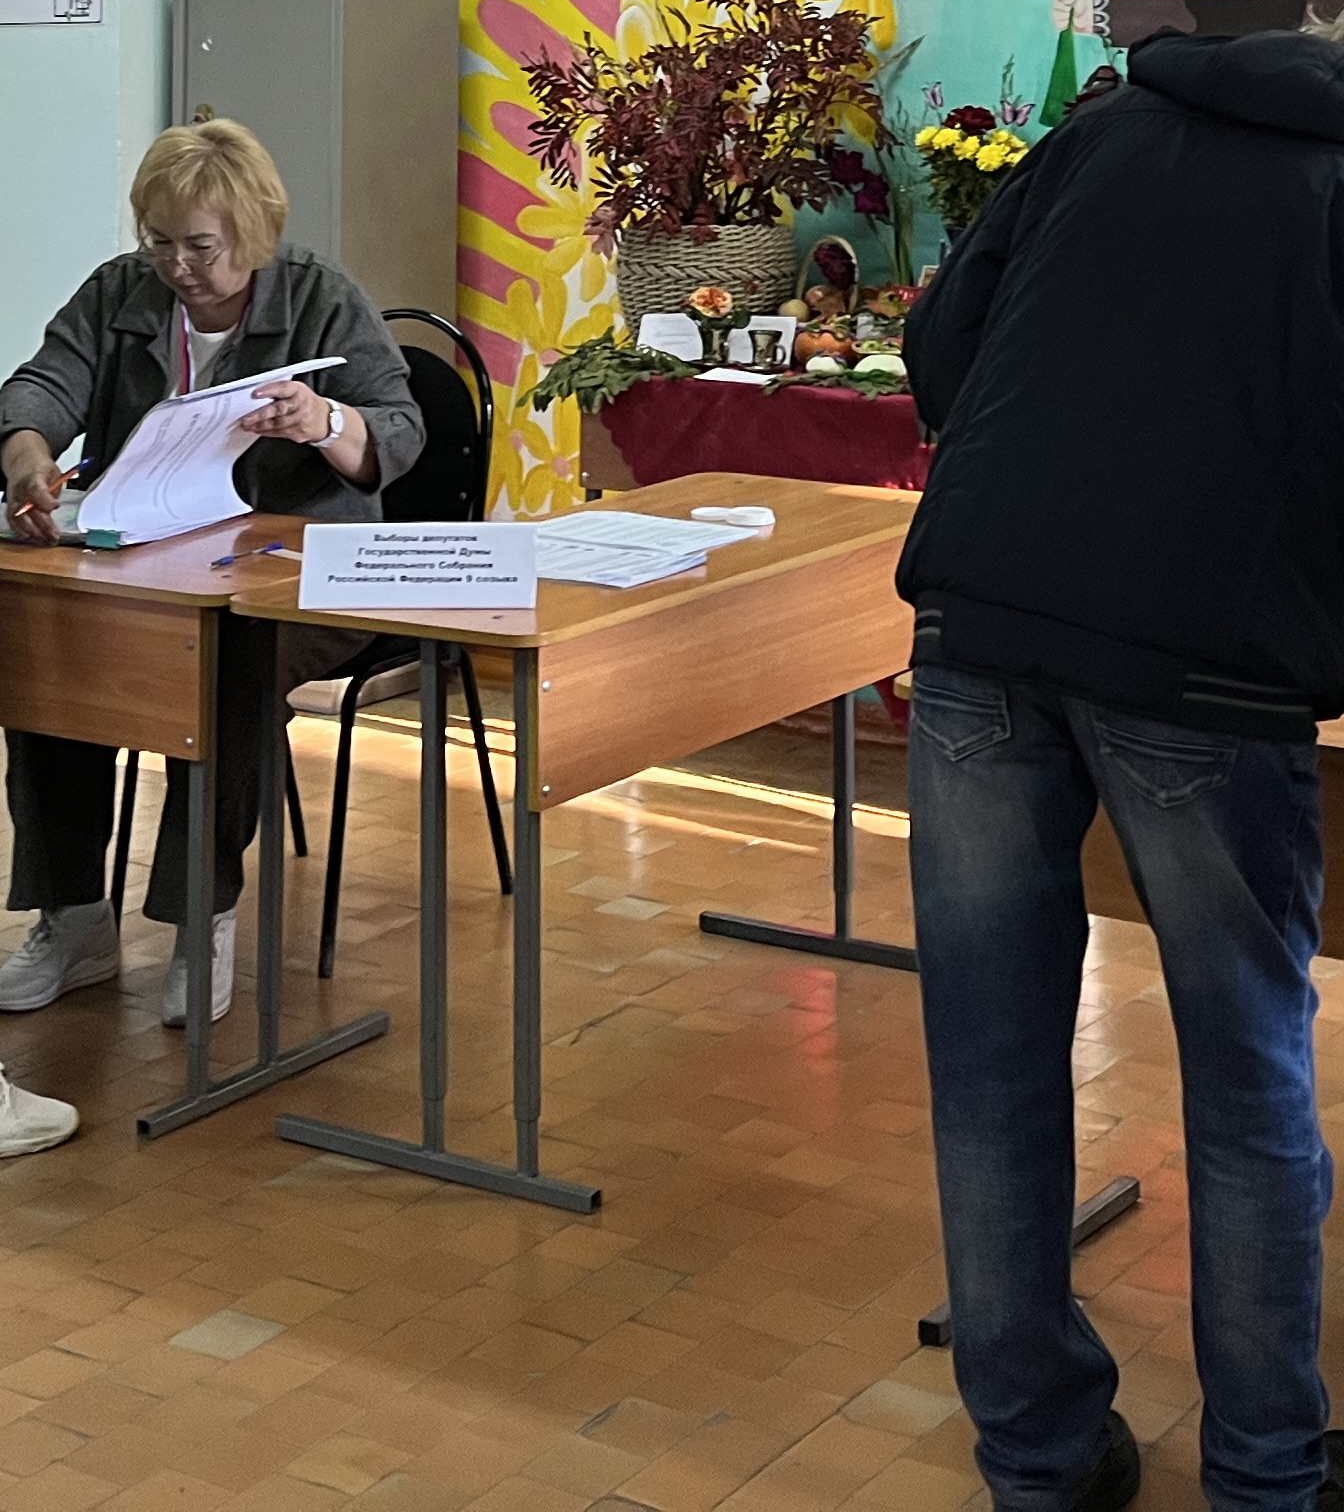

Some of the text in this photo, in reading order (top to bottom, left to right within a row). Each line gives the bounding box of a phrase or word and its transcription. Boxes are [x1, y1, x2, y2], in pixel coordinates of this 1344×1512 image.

[374, 534, 419, 543] Выборы
[358, 547, 491, 557] Государственной Думы
[354, 560, 494, 571] Федерального Собрания
[327, 574, 395, 583] Российской
[400, 574, 462, 584] Федерации
